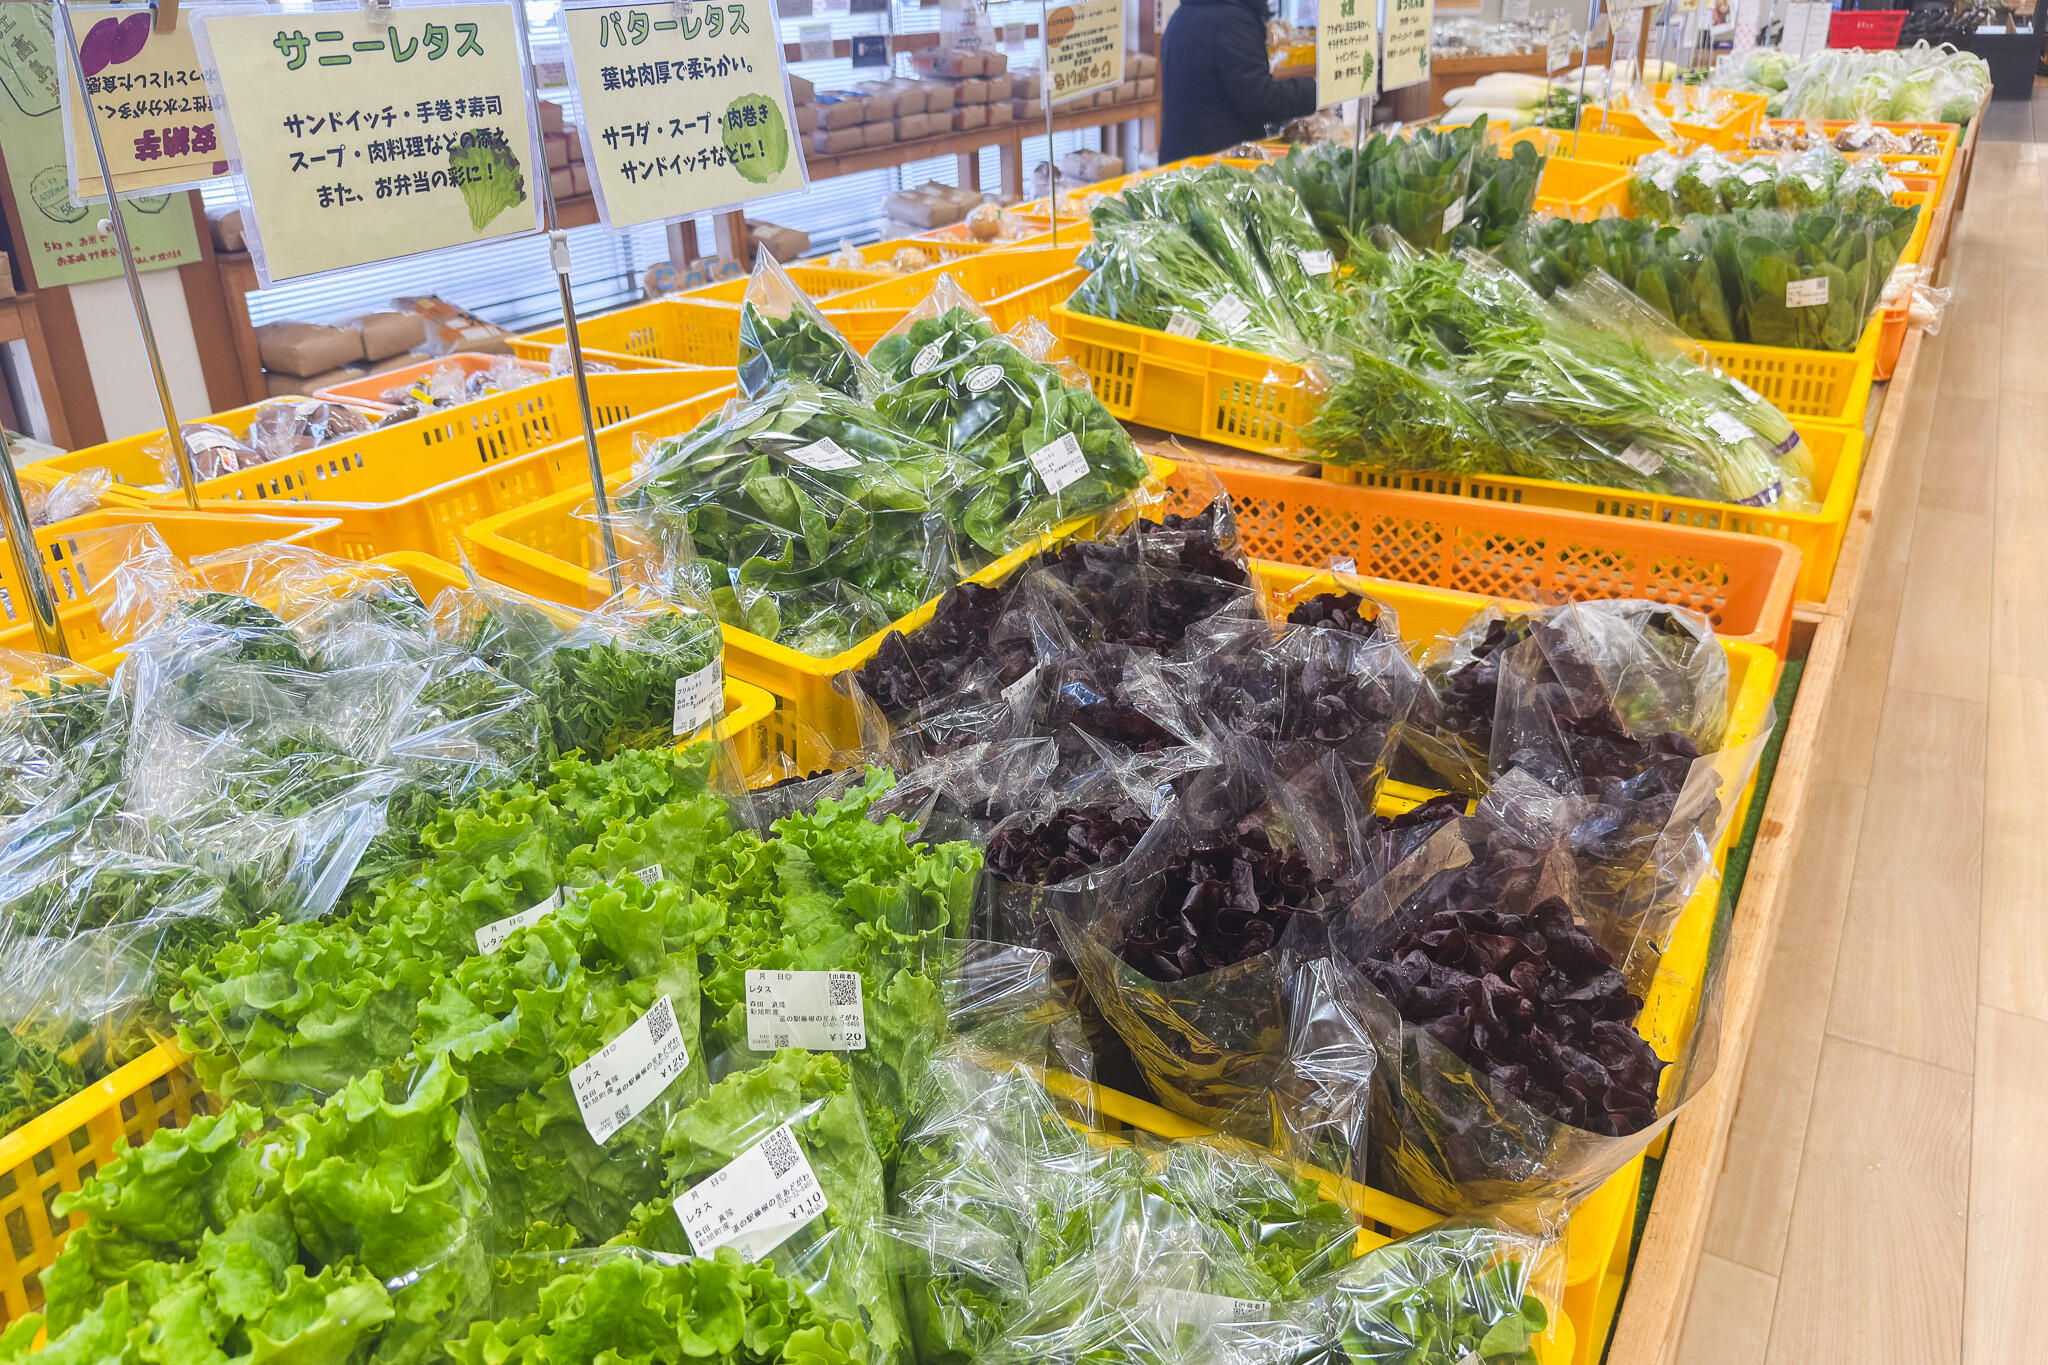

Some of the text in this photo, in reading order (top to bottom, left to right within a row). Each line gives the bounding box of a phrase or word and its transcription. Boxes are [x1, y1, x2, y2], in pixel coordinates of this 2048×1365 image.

[600, 4, 749, 47] バターレタス
[273, 22, 485, 70] サニーレタス
[601, 54, 753, 91] 葉は肉厚で柔らかい。
[283, 95, 502, 138] サンドイッチ・手巻き寿司
[602, 103, 768, 150] サラダ・スープ・肉巻き
[134, 123, 216, 161] 安納芋
[289, 126, 509, 172] スープ・肉料理などの添え
[621, 139, 765, 183] サンドイッチなどに！
[316, 163, 494, 208] また、お弁当の彩に！
[749, 985, 772, 994] レタス
[577, 1069, 601, 1090] レタス
[661, 1052, 685, 1078] ¥120
[686, 1201, 713, 1223] レタス
[789, 1191, 821, 1220] ¥110
